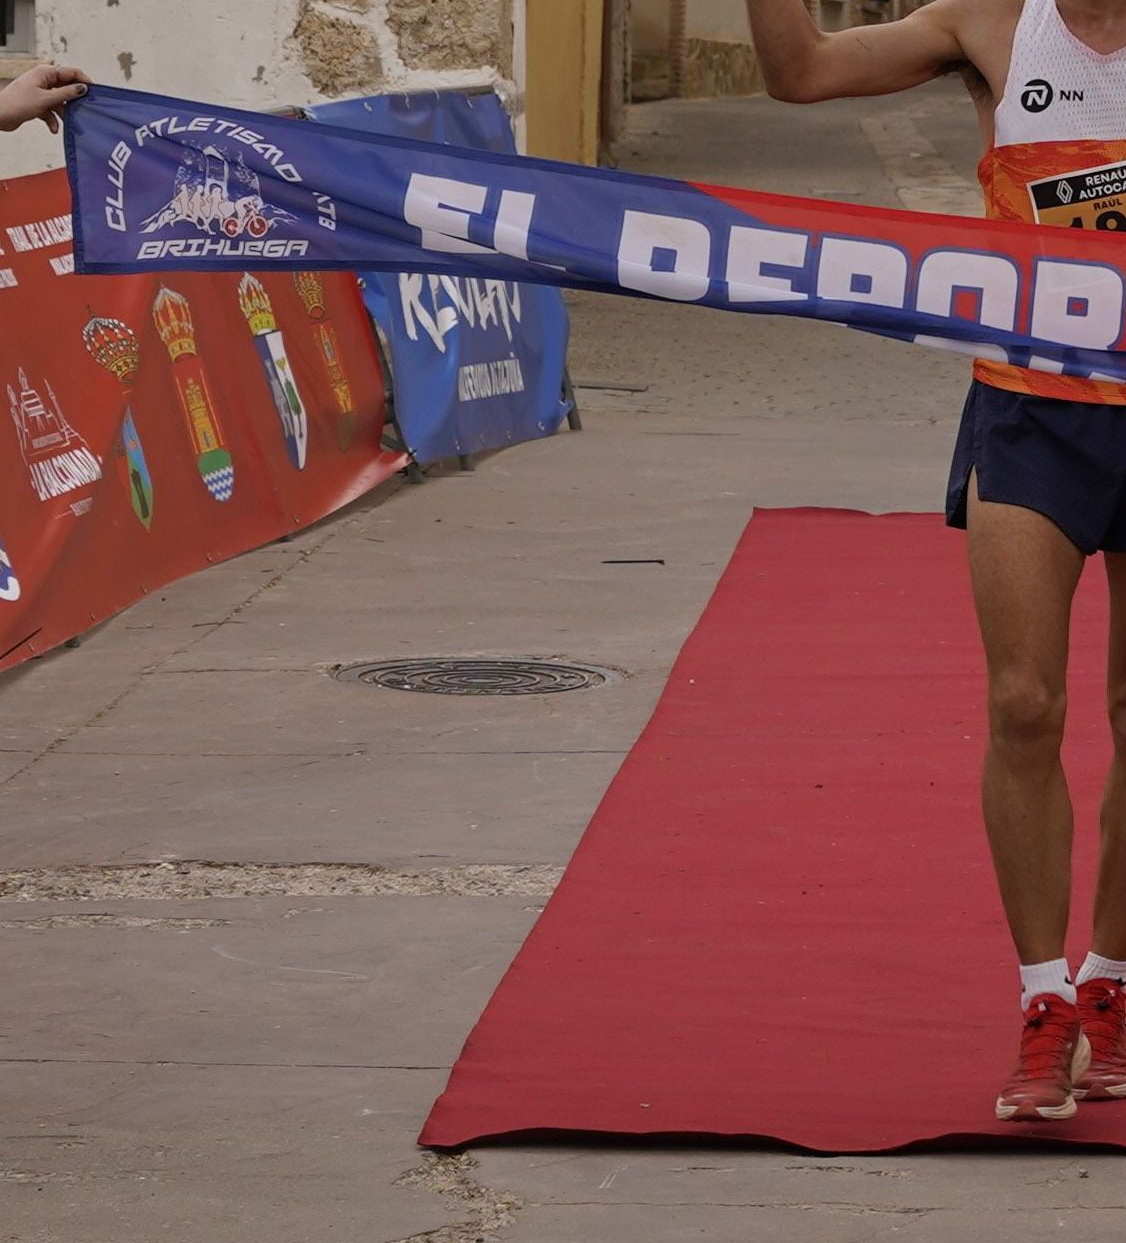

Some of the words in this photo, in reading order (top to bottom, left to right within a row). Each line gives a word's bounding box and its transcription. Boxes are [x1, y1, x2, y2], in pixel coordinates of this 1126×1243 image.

[1060, 90, 1084, 102] NN
[105, 140, 132, 232] CLUB
[135, 116, 303, 183] ATLETISMO
[1093, 197, 1123, 211] RAÚL
[403, 172, 567, 272] EL
[136, 239, 309, 260] BRIHUEGA
